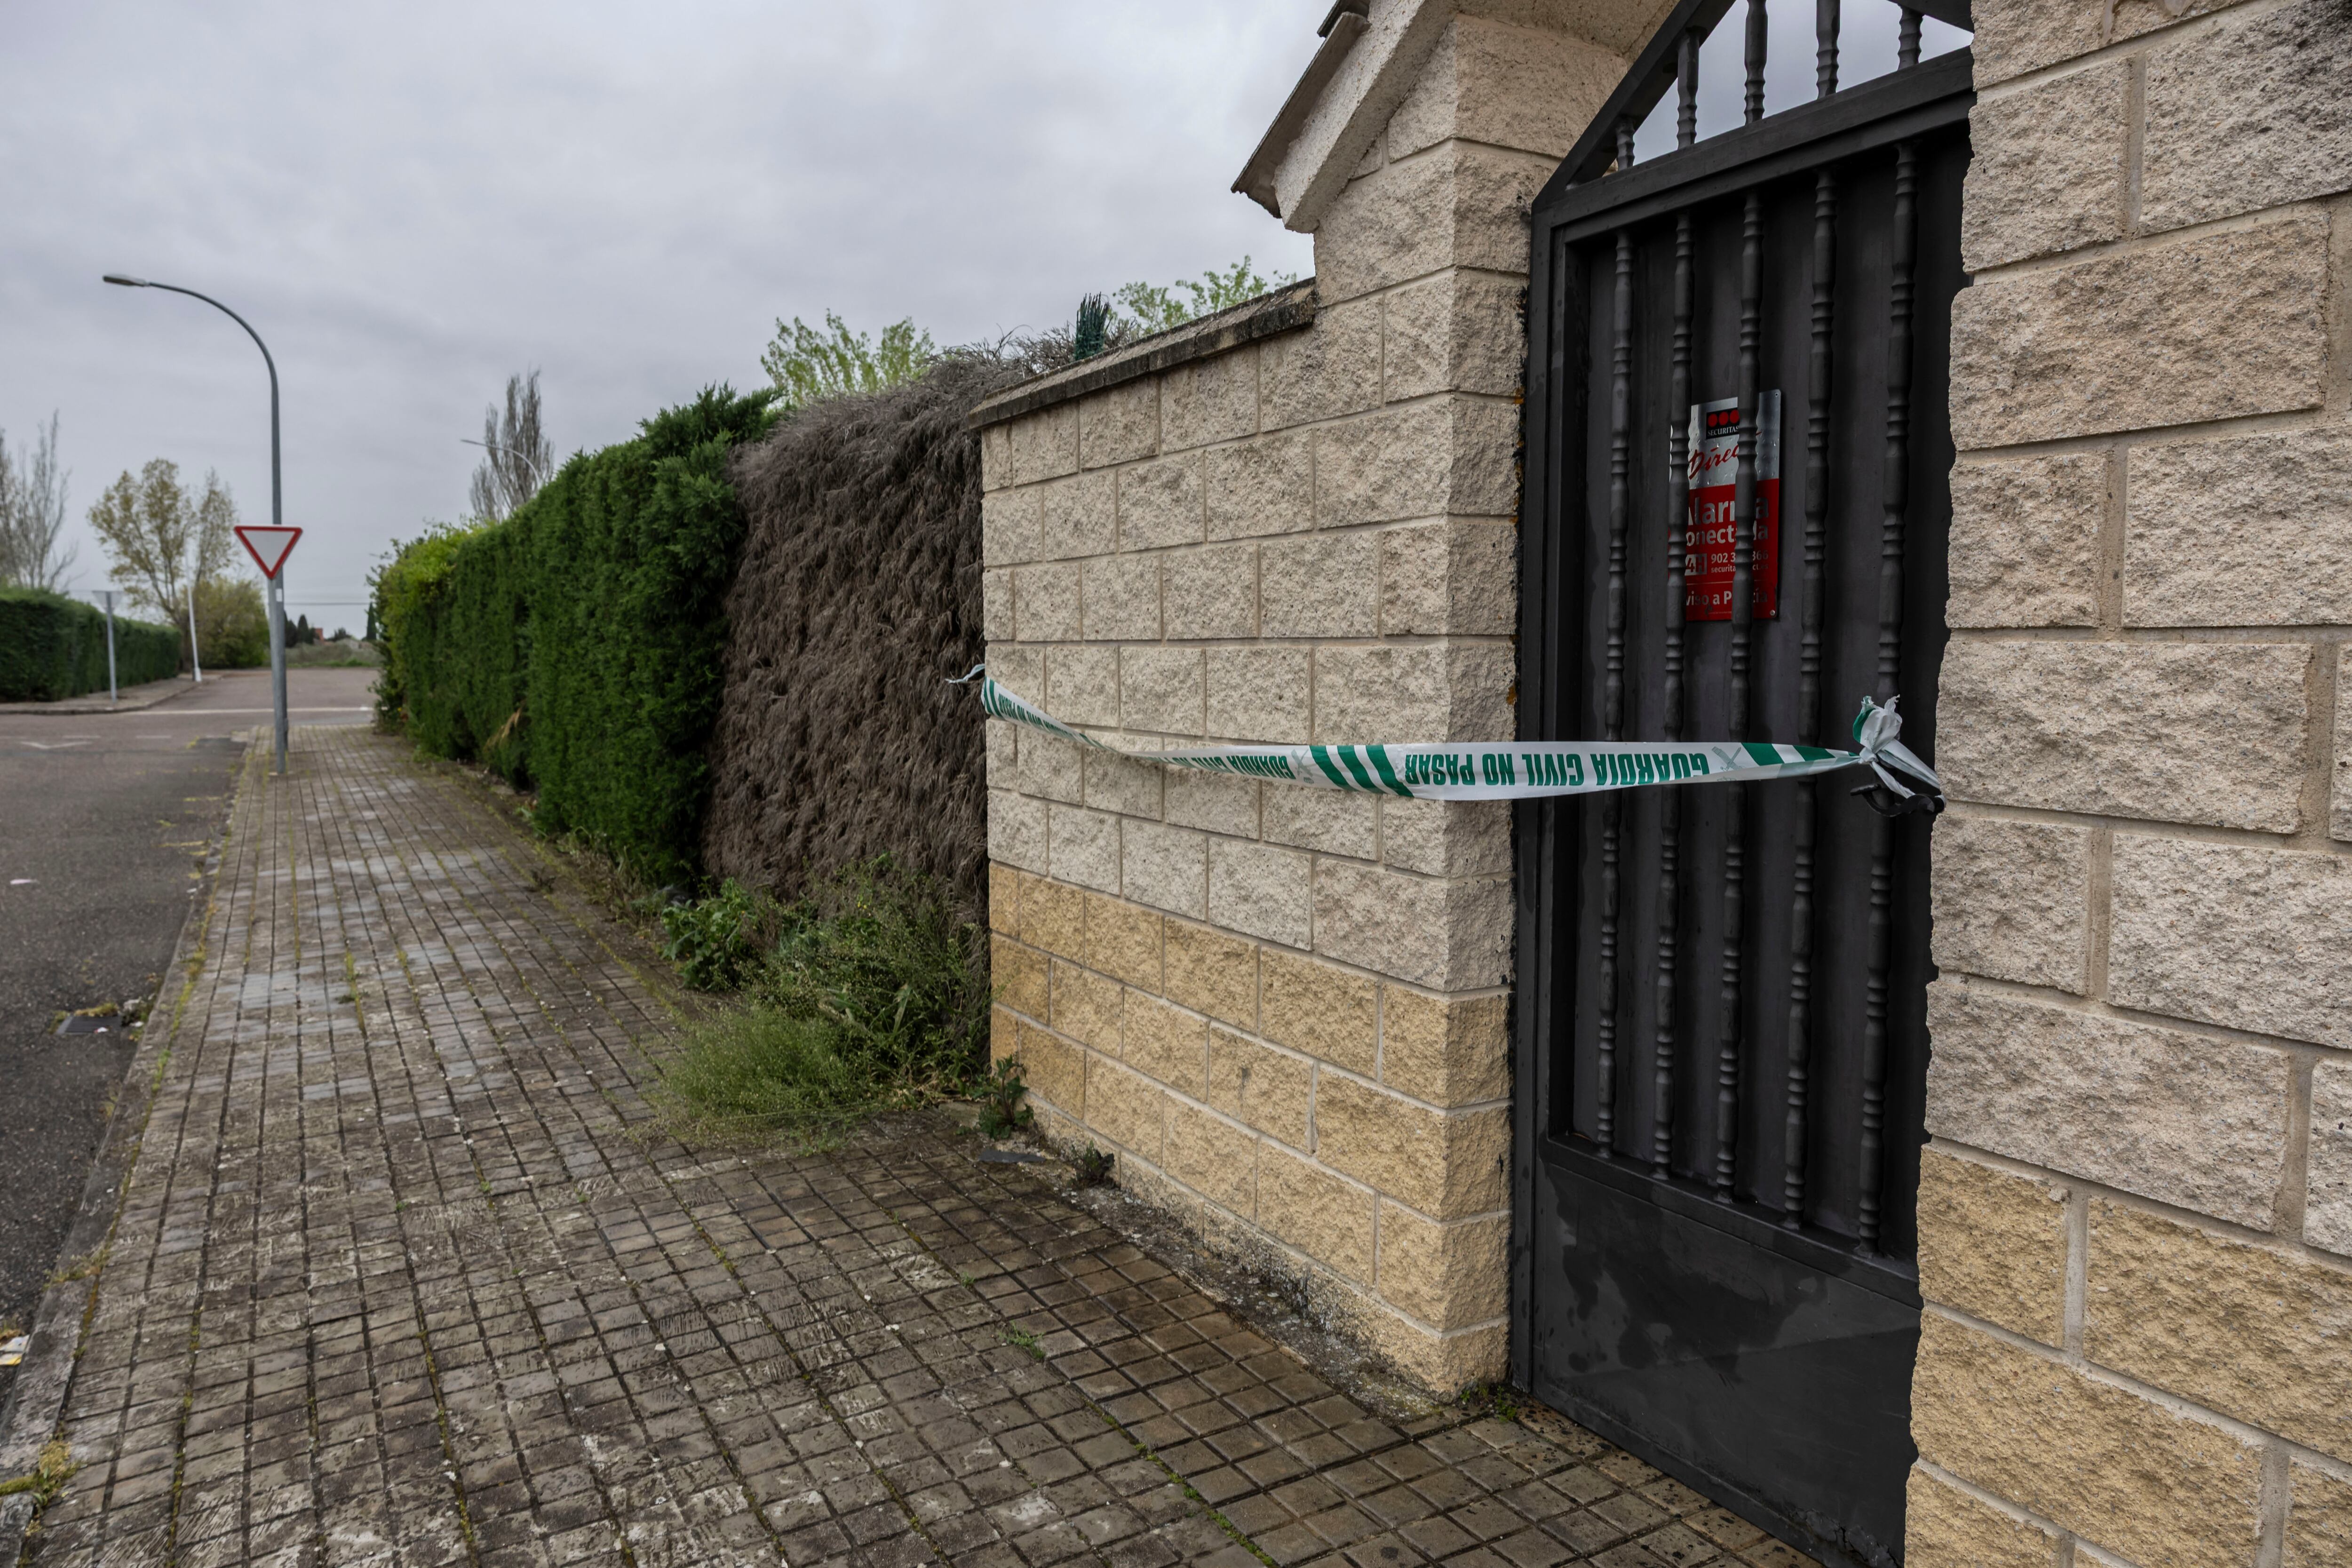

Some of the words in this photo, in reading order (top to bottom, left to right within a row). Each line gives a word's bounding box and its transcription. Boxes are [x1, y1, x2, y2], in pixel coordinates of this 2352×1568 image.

[1708, 425, 1739, 436] SECURITAS
[1711, 552, 1728, 564] 902
[1686, 590, 1709, 606] viso
[1712, 594, 1720, 605] a
[998, 693, 1018, 720] PASAR
[1191, 756, 1235, 774] CIVIL
[1226, 755, 1296, 780] GUARDIA
[1405, 754, 1476, 786] PASAR
[1482, 753, 1515, 785] NO
[1522, 753, 1585, 786] CIVIL
[1589, 753, 1710, 786] GUARDIA
